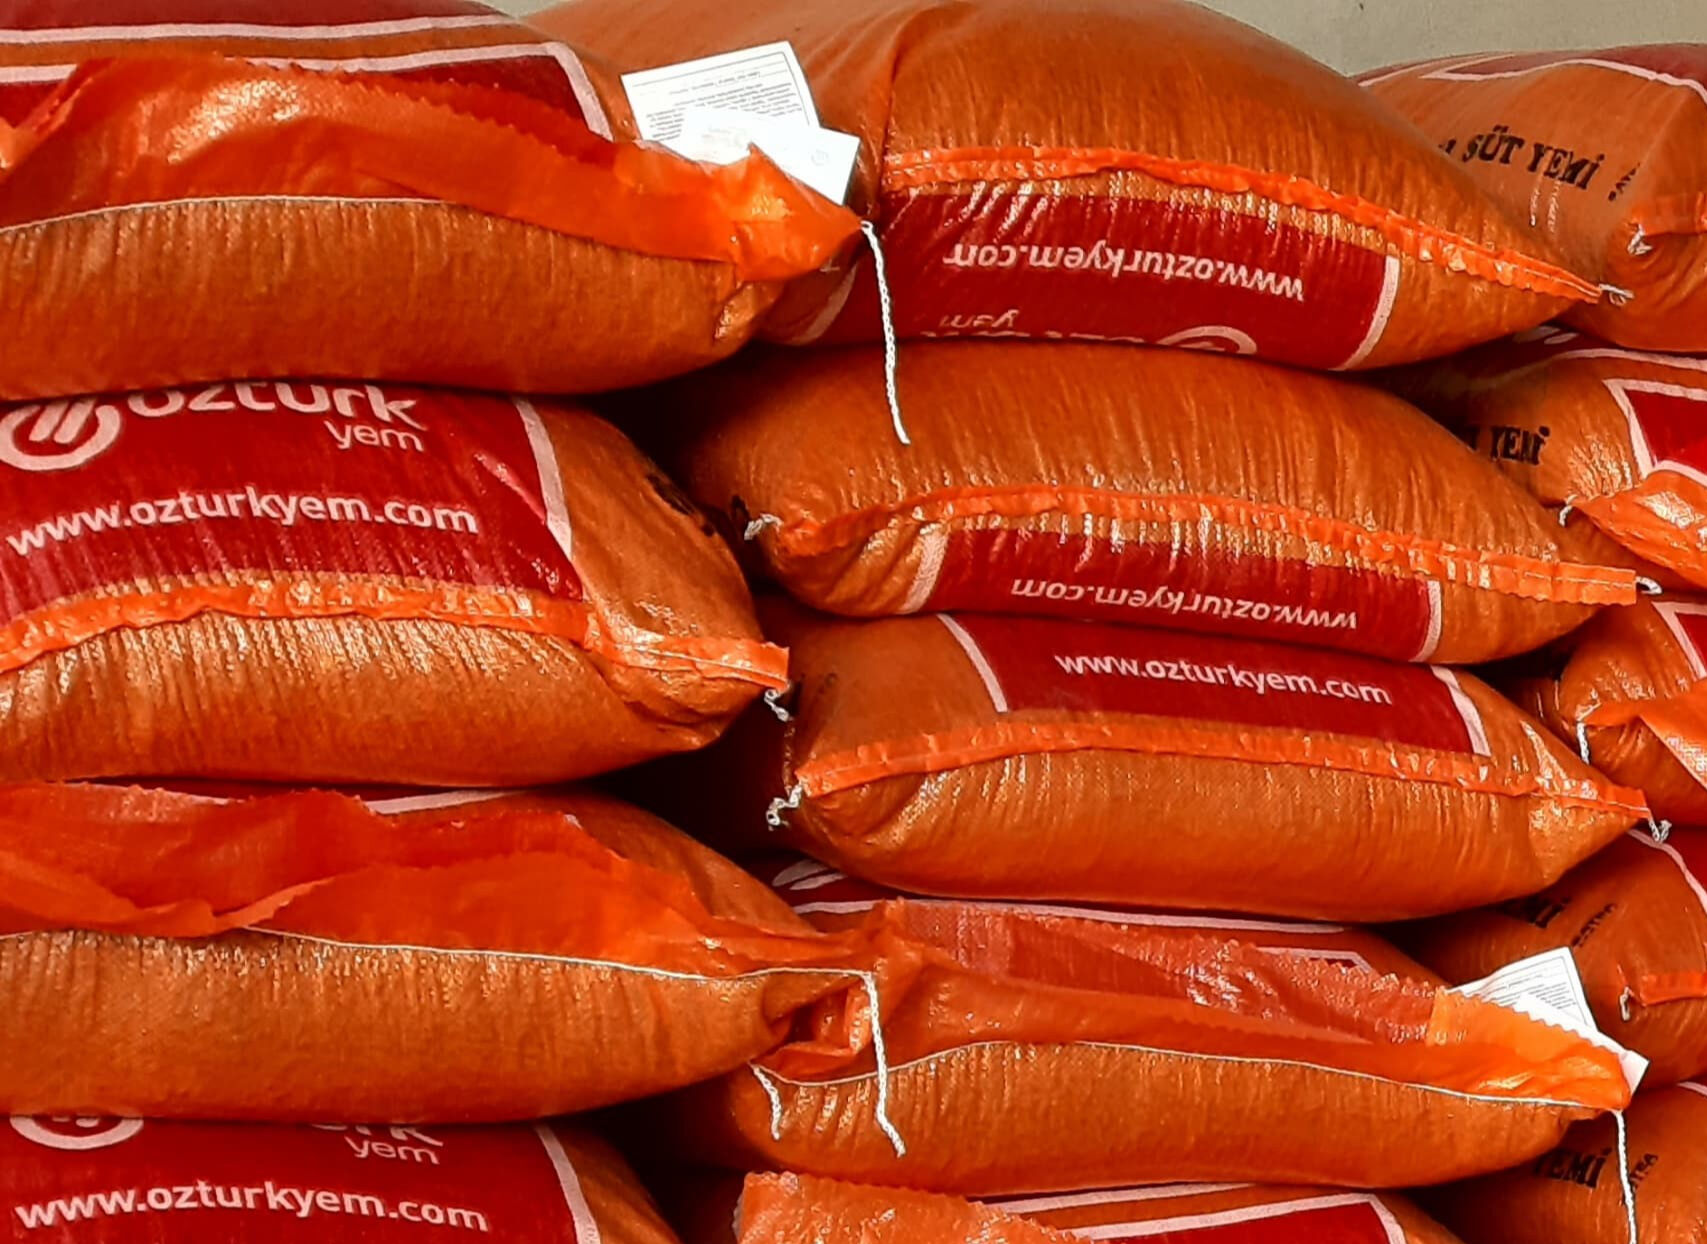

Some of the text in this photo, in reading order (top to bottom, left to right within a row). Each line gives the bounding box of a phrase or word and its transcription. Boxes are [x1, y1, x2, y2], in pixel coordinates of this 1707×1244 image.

[1462, 124, 1525, 164] SÜT
[325, 419, 423, 452] yem
[5, 487, 479, 557] www.ozturkyem.com
[1009, 574, 1358, 634] www.ozturkyem.com
[1054, 648, 1393, 708] www.ozturkyem.com
[345, 1135, 441, 1165] yem
[14, 1178, 489, 1233] www.ozturkyem.com
